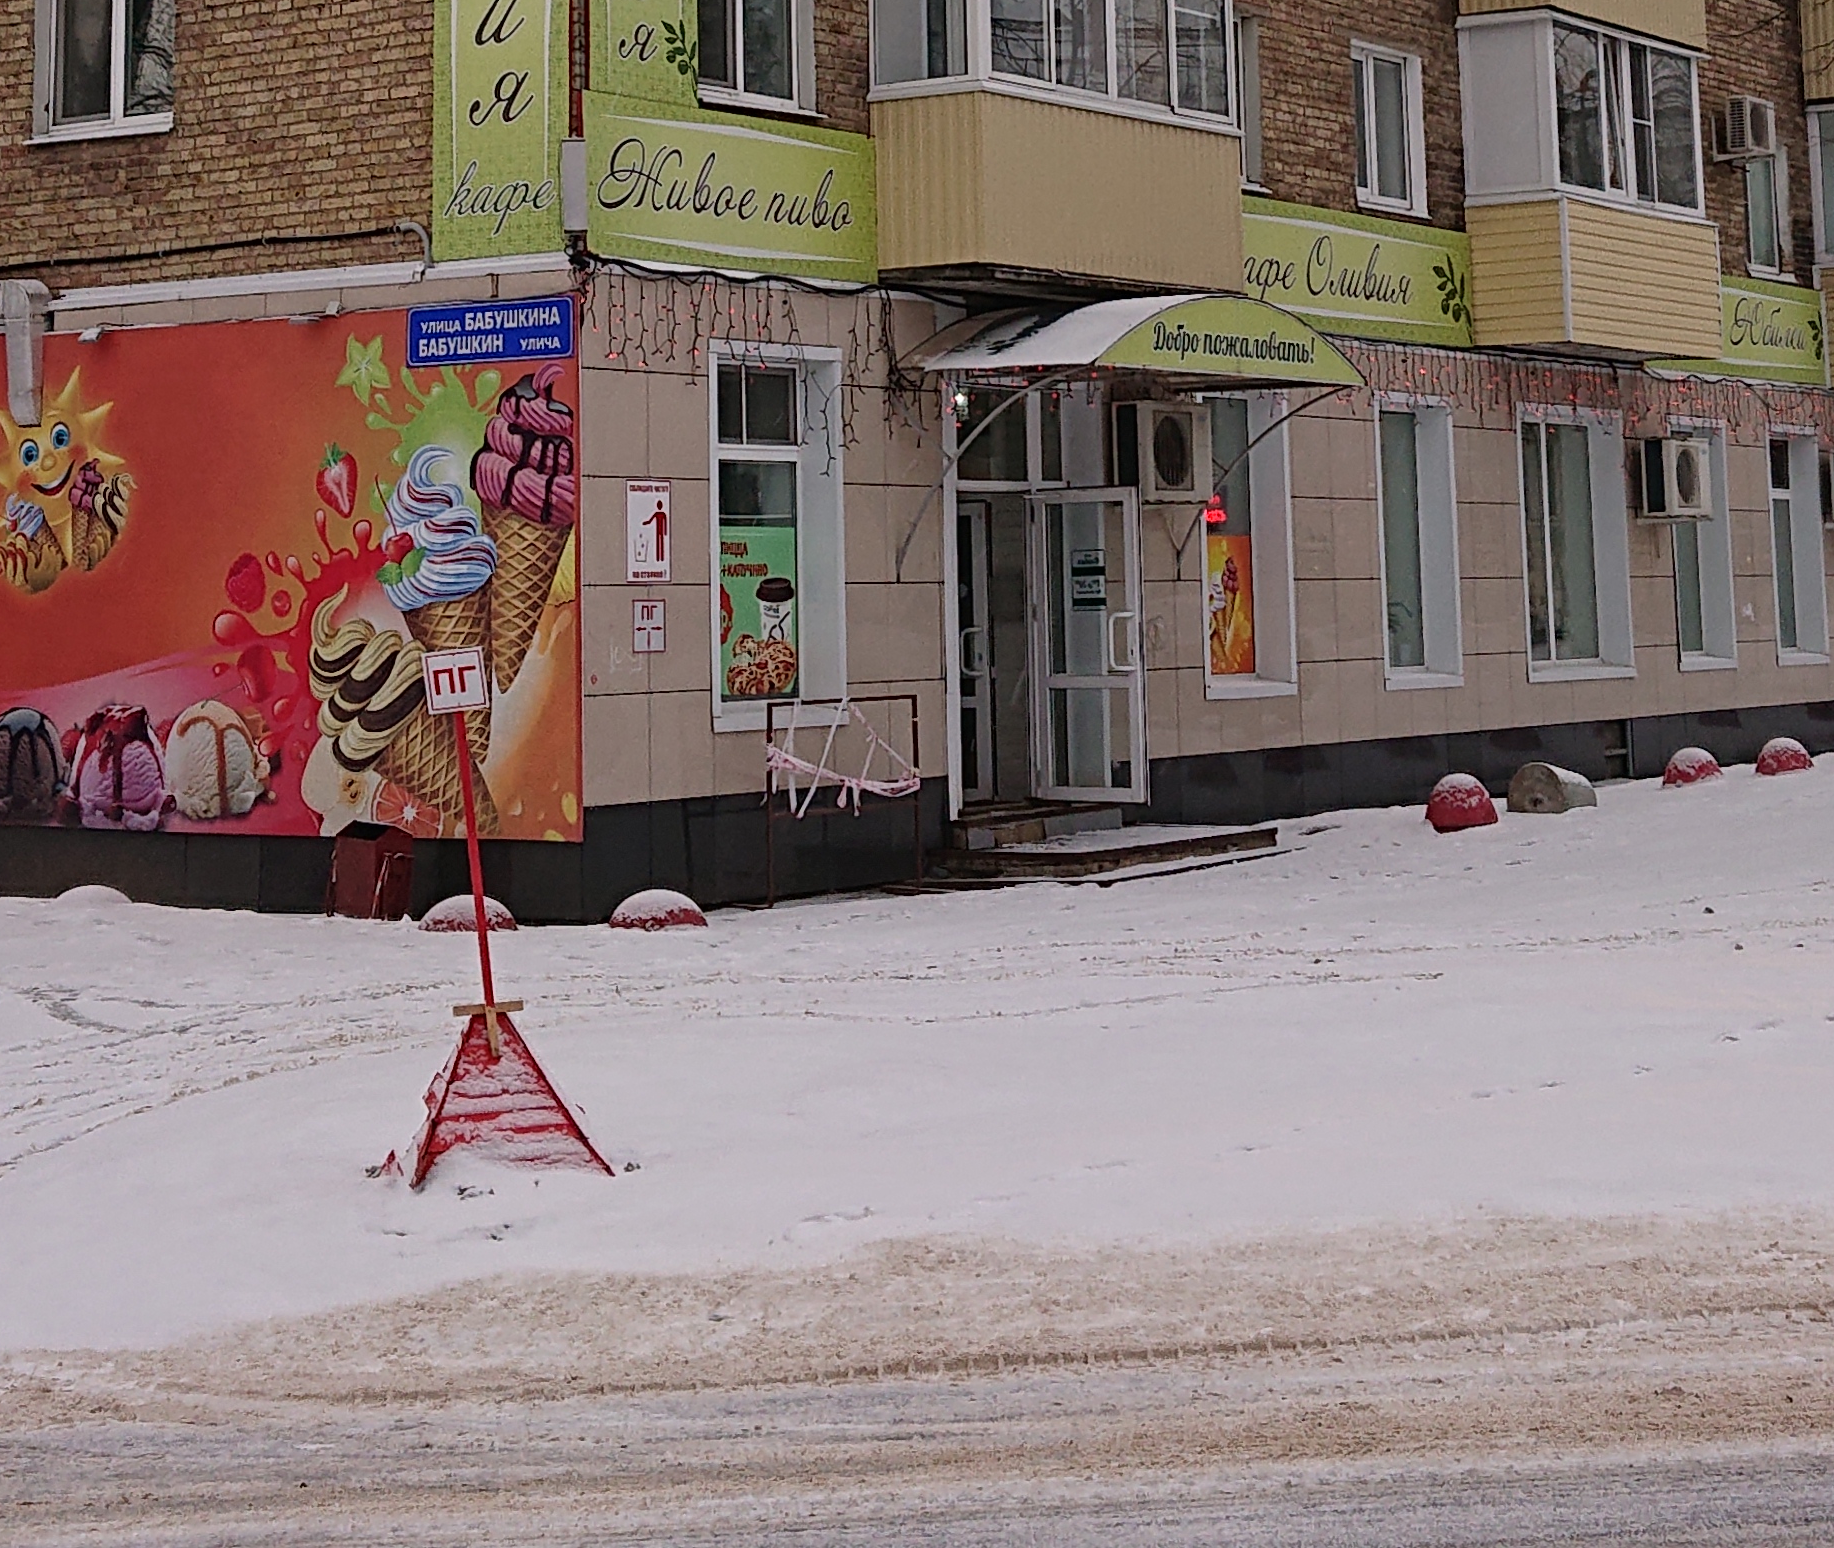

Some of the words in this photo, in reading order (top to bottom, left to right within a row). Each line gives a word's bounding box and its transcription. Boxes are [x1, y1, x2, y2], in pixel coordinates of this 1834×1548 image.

[443, 160, 557, 236] кафе
[597, 137, 758, 220] Живое
[765, 169, 855, 232] пиво
[1306, 234, 1414, 305] Оливия
[420, 319, 462, 334] УЛИЦА
[464, 306, 562, 332] БАБУШКИНА
[418, 333, 504, 358] БАБУШКИН
[519, 336, 562, 351] УЛИЧА
[1153, 320, 1202, 361] Добро
[1202, 330, 1316, 364] пожаловать!
[641, 605, 658, 621] ПГ
[432, 665, 476, 696] ПГ
